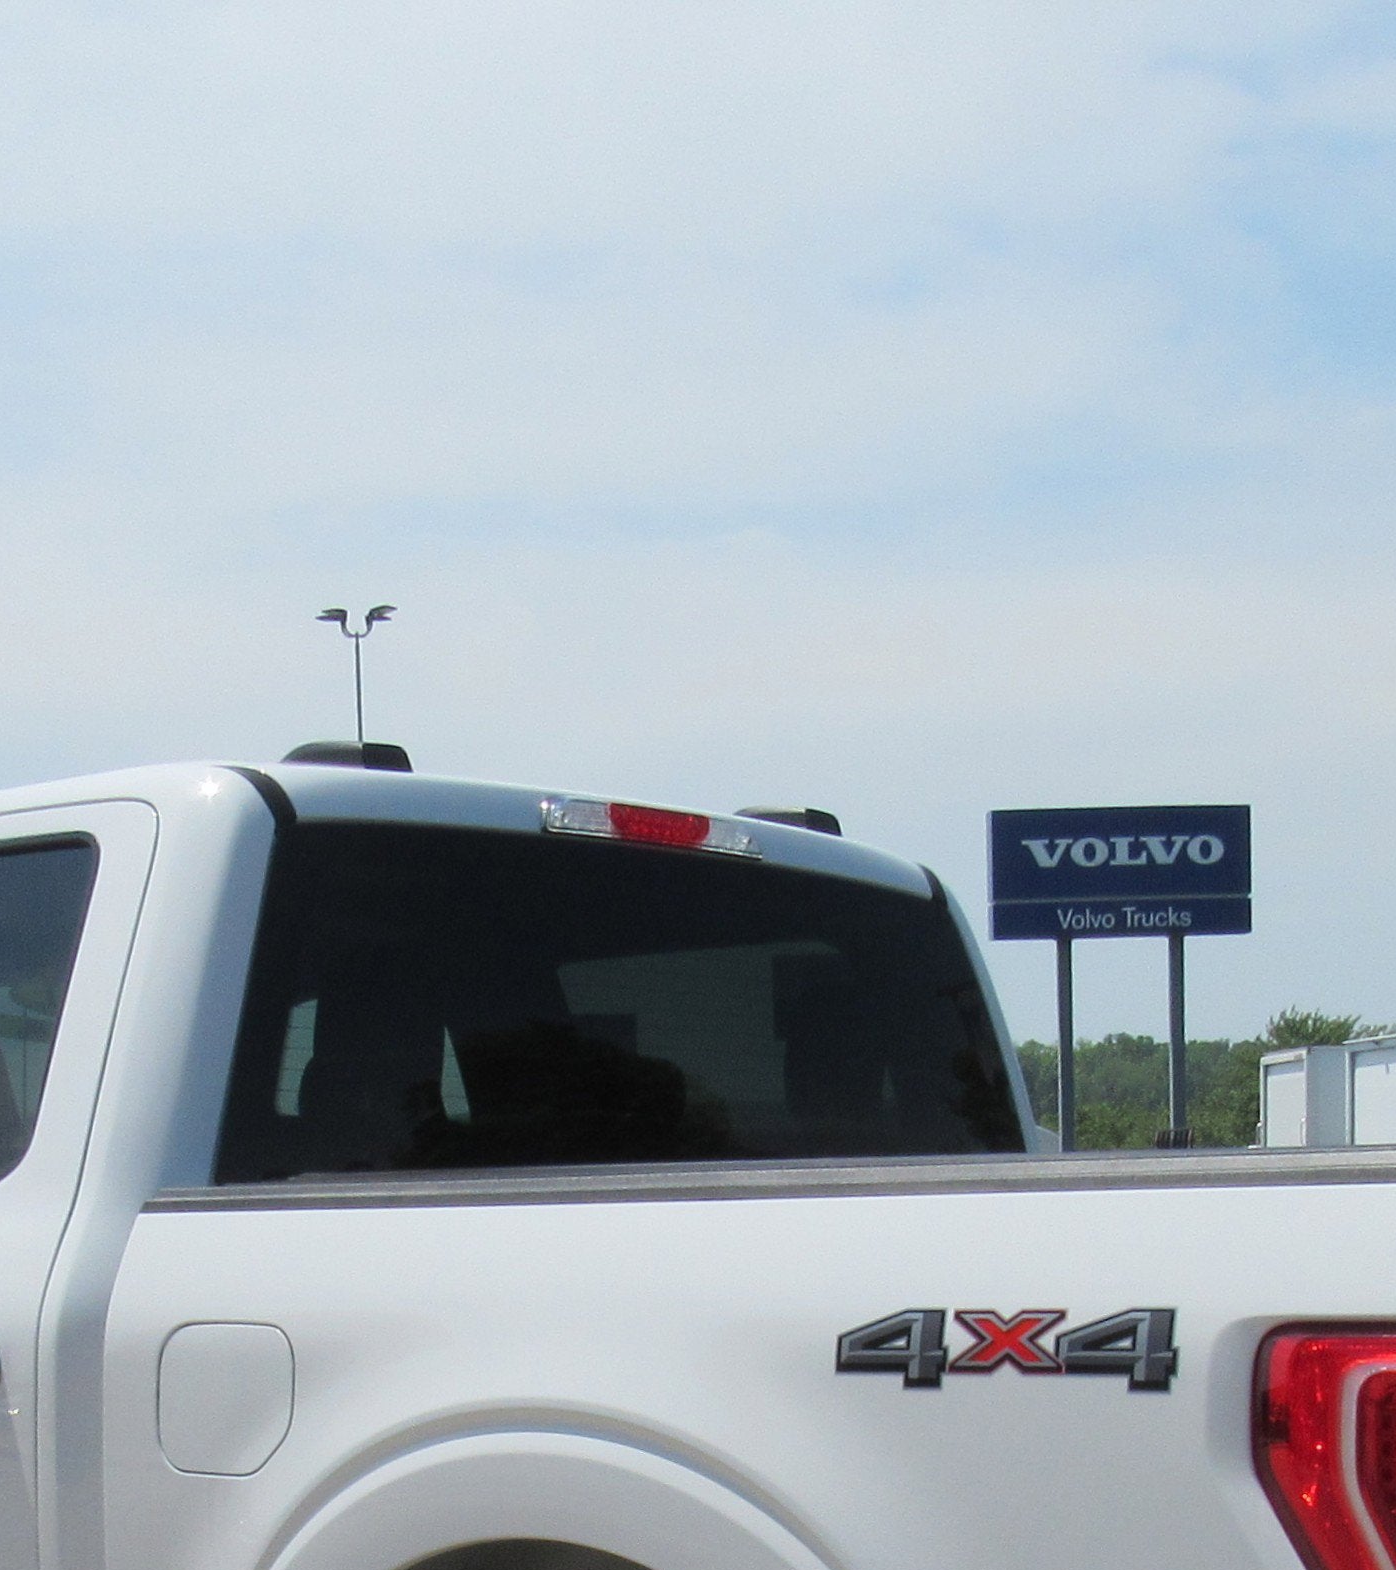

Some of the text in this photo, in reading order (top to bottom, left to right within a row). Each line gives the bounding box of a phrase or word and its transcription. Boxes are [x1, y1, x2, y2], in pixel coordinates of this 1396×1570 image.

[1021, 834, 1225, 868] VOLVO
[1057, 906, 1193, 930] Volvo Trucks
